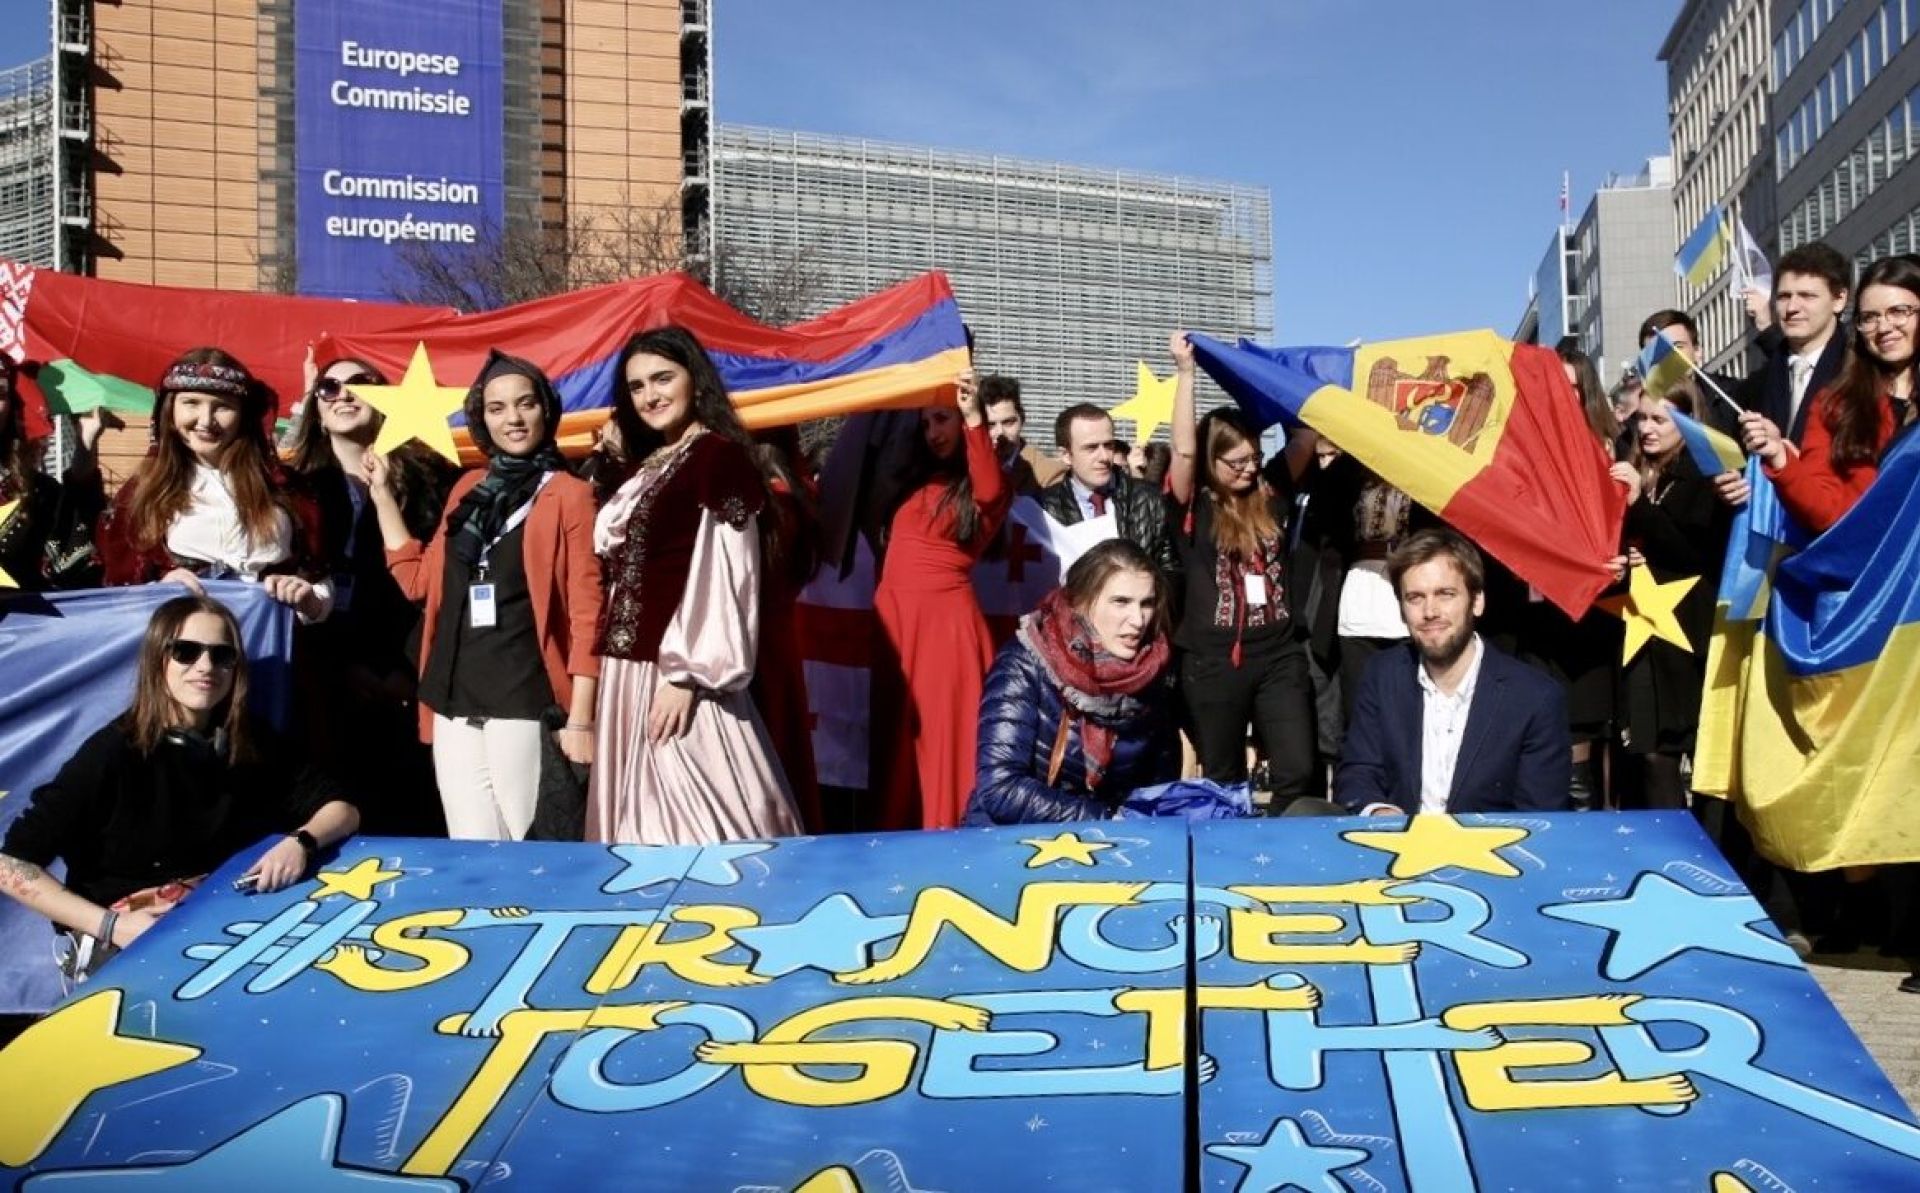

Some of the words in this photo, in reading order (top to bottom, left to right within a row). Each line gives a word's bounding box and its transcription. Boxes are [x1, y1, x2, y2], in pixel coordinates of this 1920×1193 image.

[341, 41, 460, 76] Europese
[330, 80, 471, 116] Commissie
[322, 169, 479, 204] Commission
[326, 212, 477, 244] européenne
[435, 971, 1920, 1193] TOGETHER
